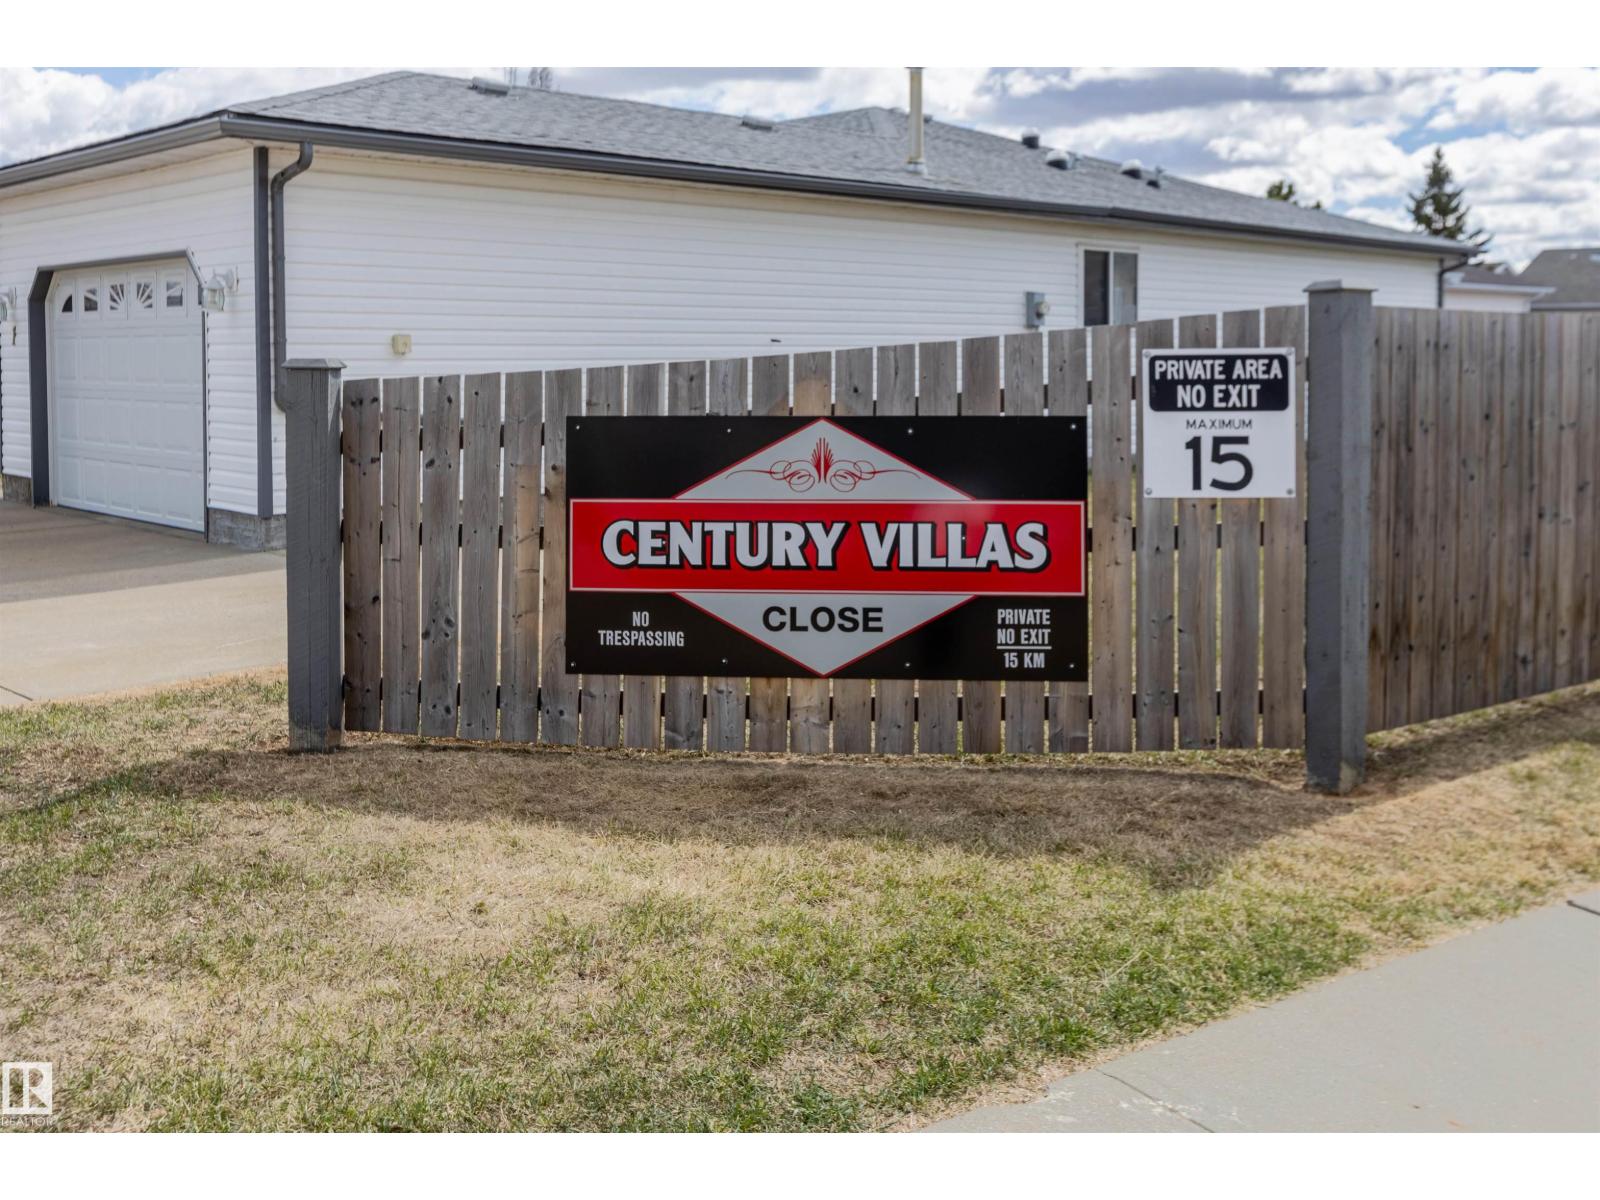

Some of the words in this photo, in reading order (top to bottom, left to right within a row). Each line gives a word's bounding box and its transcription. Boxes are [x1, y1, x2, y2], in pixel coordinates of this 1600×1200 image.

[1154, 359, 1226, 380] PRIVATE
[1232, 358, 1283, 380] AREA
[1176, 384, 1207, 408] NO
[1213, 384, 1261, 408] EXIT
[1185, 419, 1253, 430] MAXIMUM
[1185, 436, 1253, 492] 15
[601, 519, 845, 569] CENTURY
[860, 521, 1051, 573] VILLAS
[632, 611, 650, 627] NO
[762, 606, 884, 633] CLOSE
[997, 608, 1051, 625] PRIVATE
[598, 630, 685, 647] TRESPASSING
[996, 628, 1015, 644] NO
[1020, 628, 1051, 644] EXIT
[1003, 652, 1018, 668] 15
[1023, 652, 1045, 668] KM
